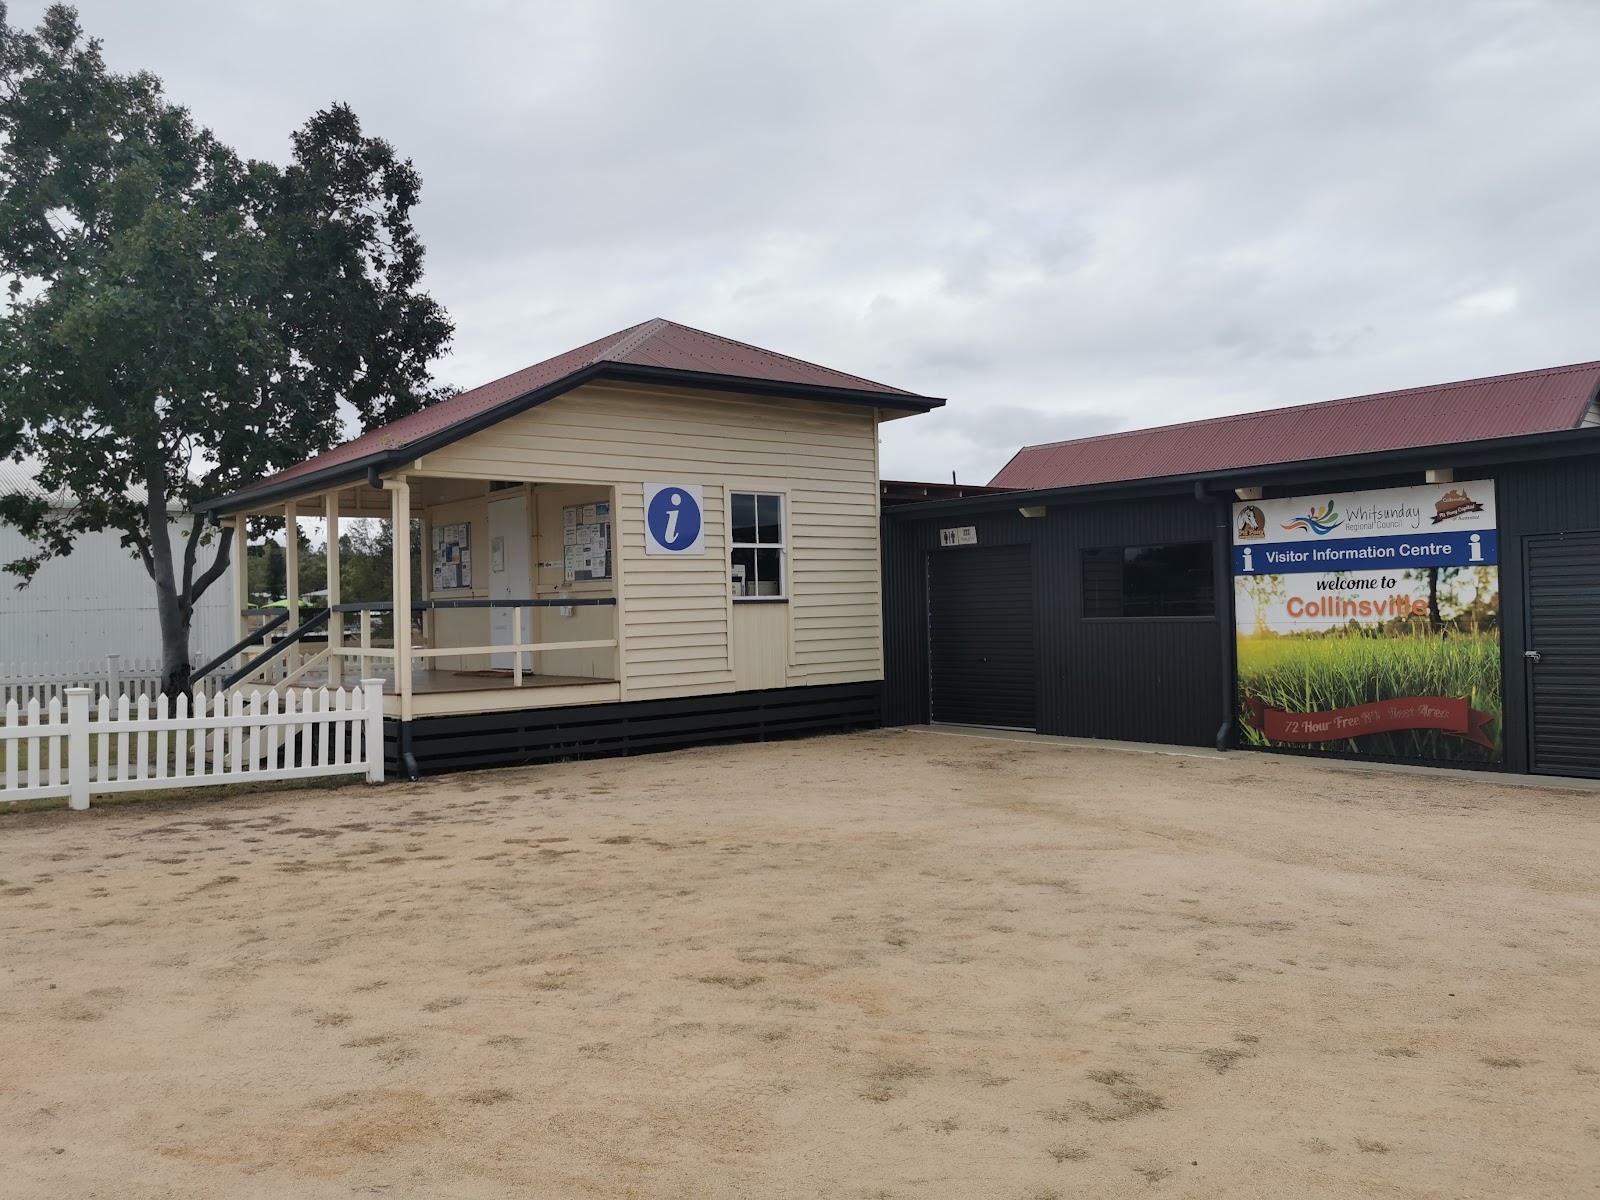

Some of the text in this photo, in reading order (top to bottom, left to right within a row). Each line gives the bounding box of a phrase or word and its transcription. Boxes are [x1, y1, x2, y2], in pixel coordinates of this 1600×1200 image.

[1346, 502, 1420, 529] Whitsunday
[1345, 519, 1403, 532] Regional Council
[1265, 550, 1309, 563] Visitor
[1312, 546, 1395, 561] Information
[1399, 543, 1452, 556] Centre
[1316, 576, 1397, 590] welcome to
[1286, 594, 1429, 617] Collinsville
[1285, 721, 1299, 733] 72
[1301, 720, 1332, 733] Hour
[1333, 715, 1360, 729] Free
